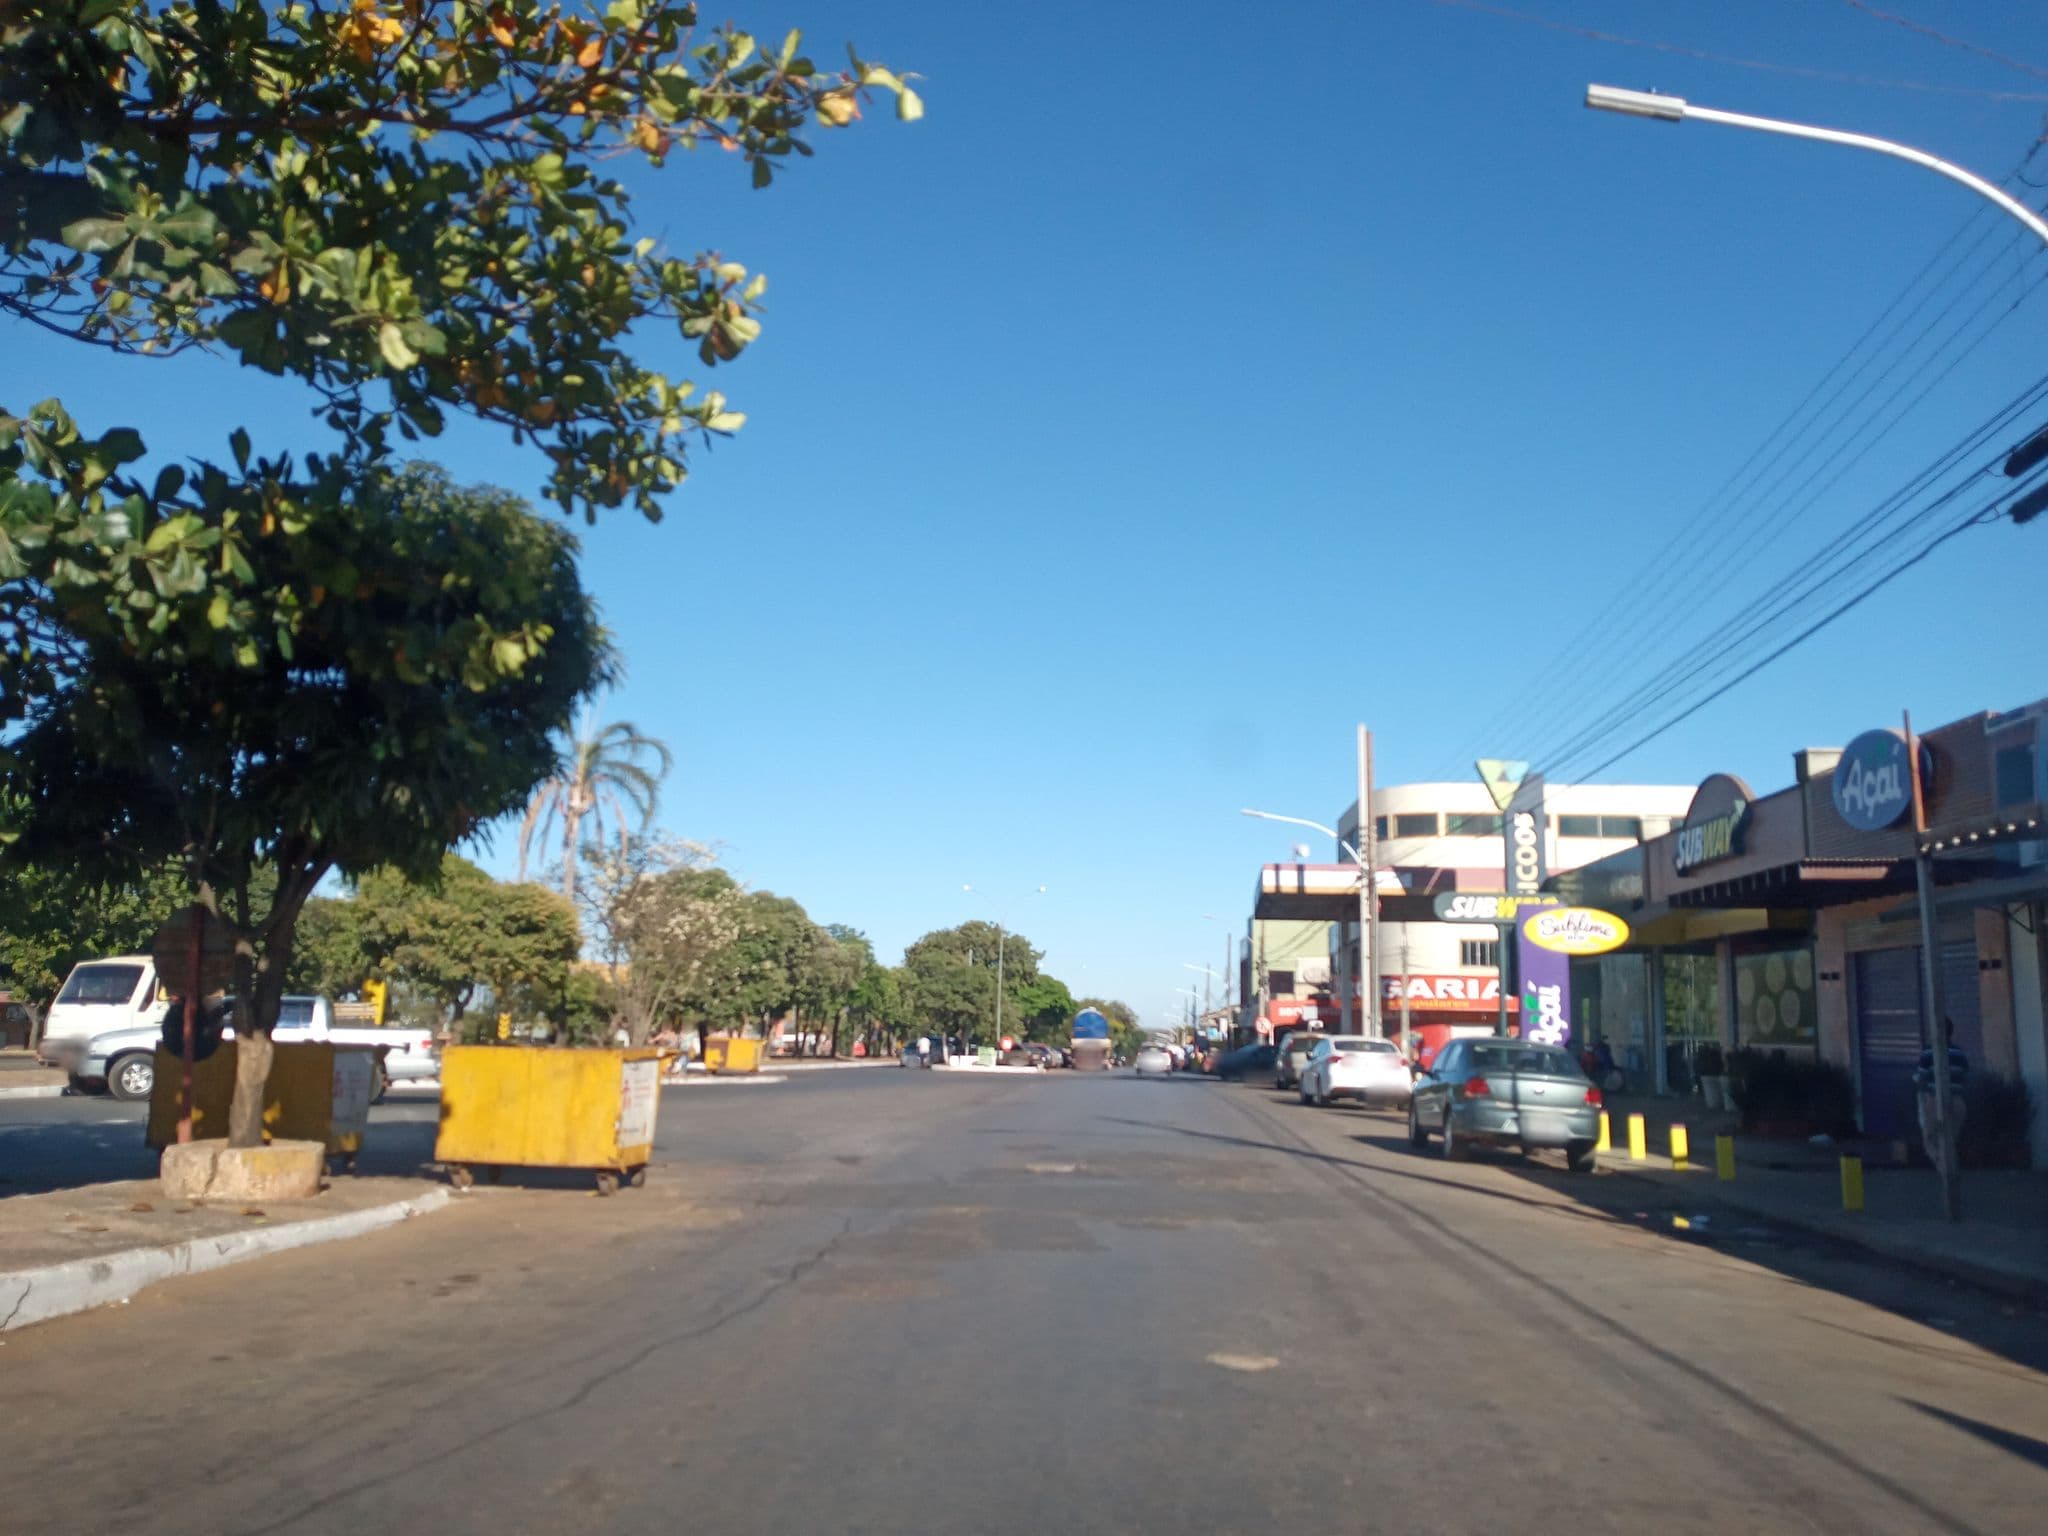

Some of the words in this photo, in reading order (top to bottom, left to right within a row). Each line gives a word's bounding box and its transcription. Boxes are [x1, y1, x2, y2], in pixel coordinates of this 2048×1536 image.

[1842, 743, 1903, 818] Açaí
[1676, 799, 1746, 869] SUBWAY
[1443, 896, 1559, 919] SUBW
[1353, 978, 1513, 1000] GARIA
